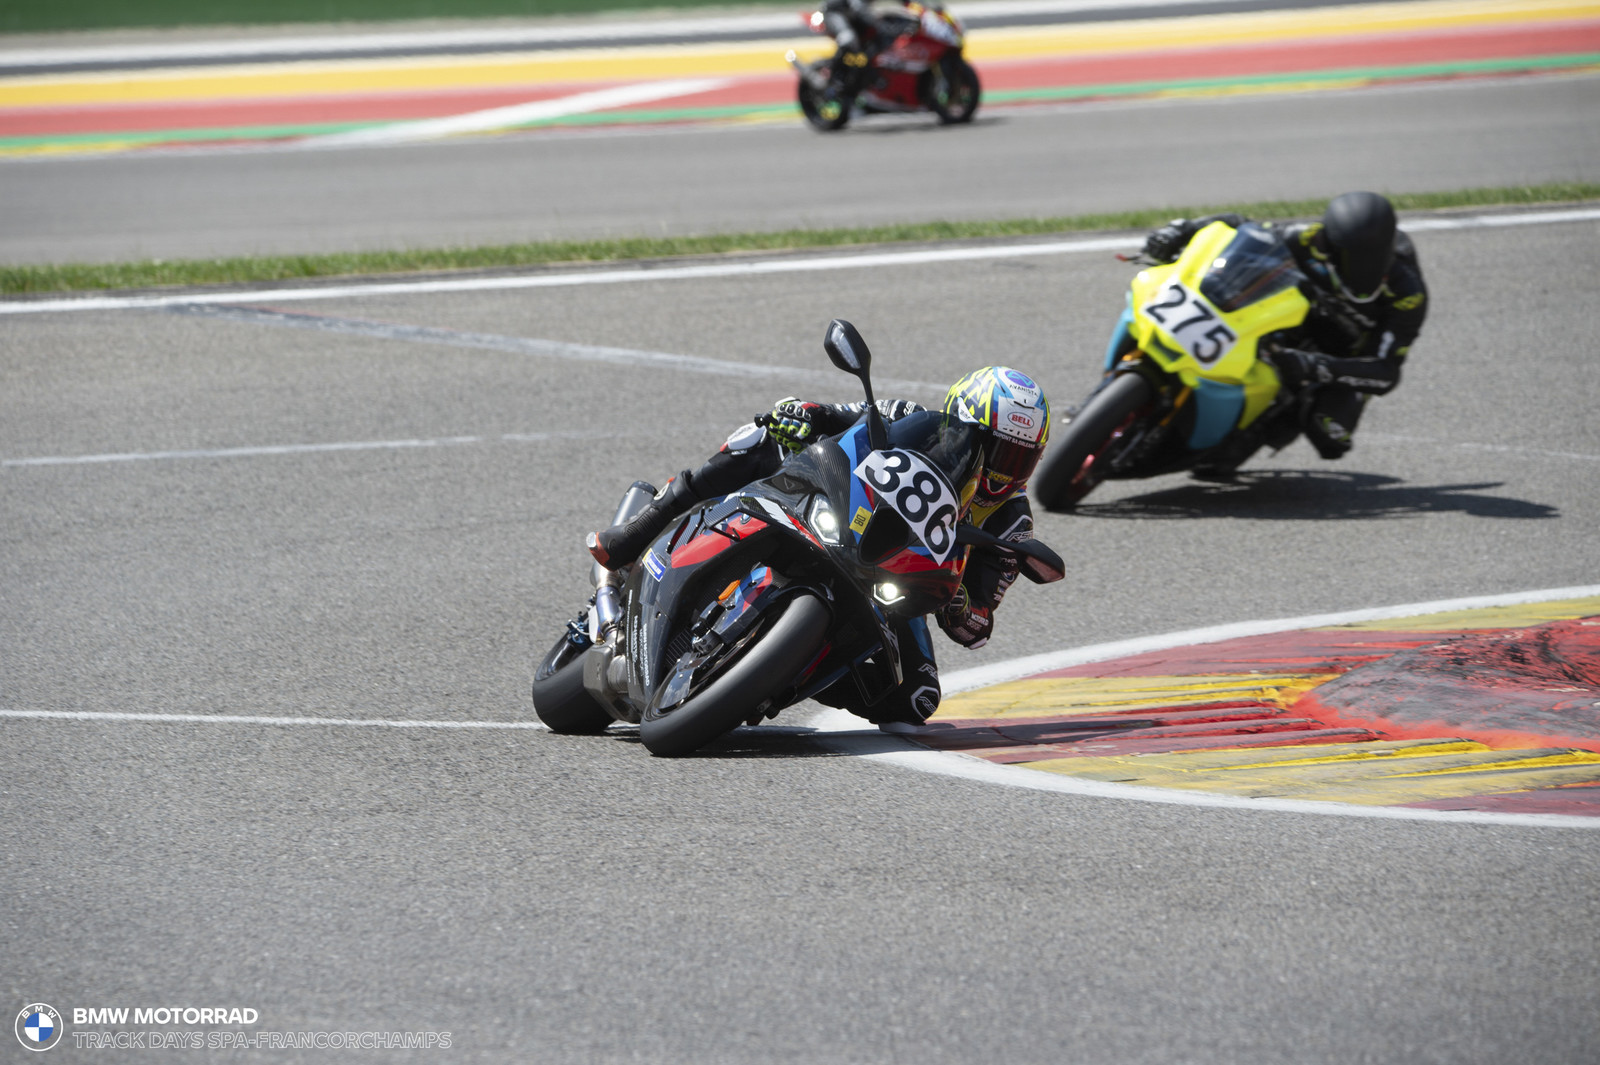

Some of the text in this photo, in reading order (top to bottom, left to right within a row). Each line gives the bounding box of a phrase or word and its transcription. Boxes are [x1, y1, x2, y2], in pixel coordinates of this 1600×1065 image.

[1146, 284, 1236, 363] 275
[1011, 414, 1031, 427] BELL
[865, 451, 957, 555] 386
